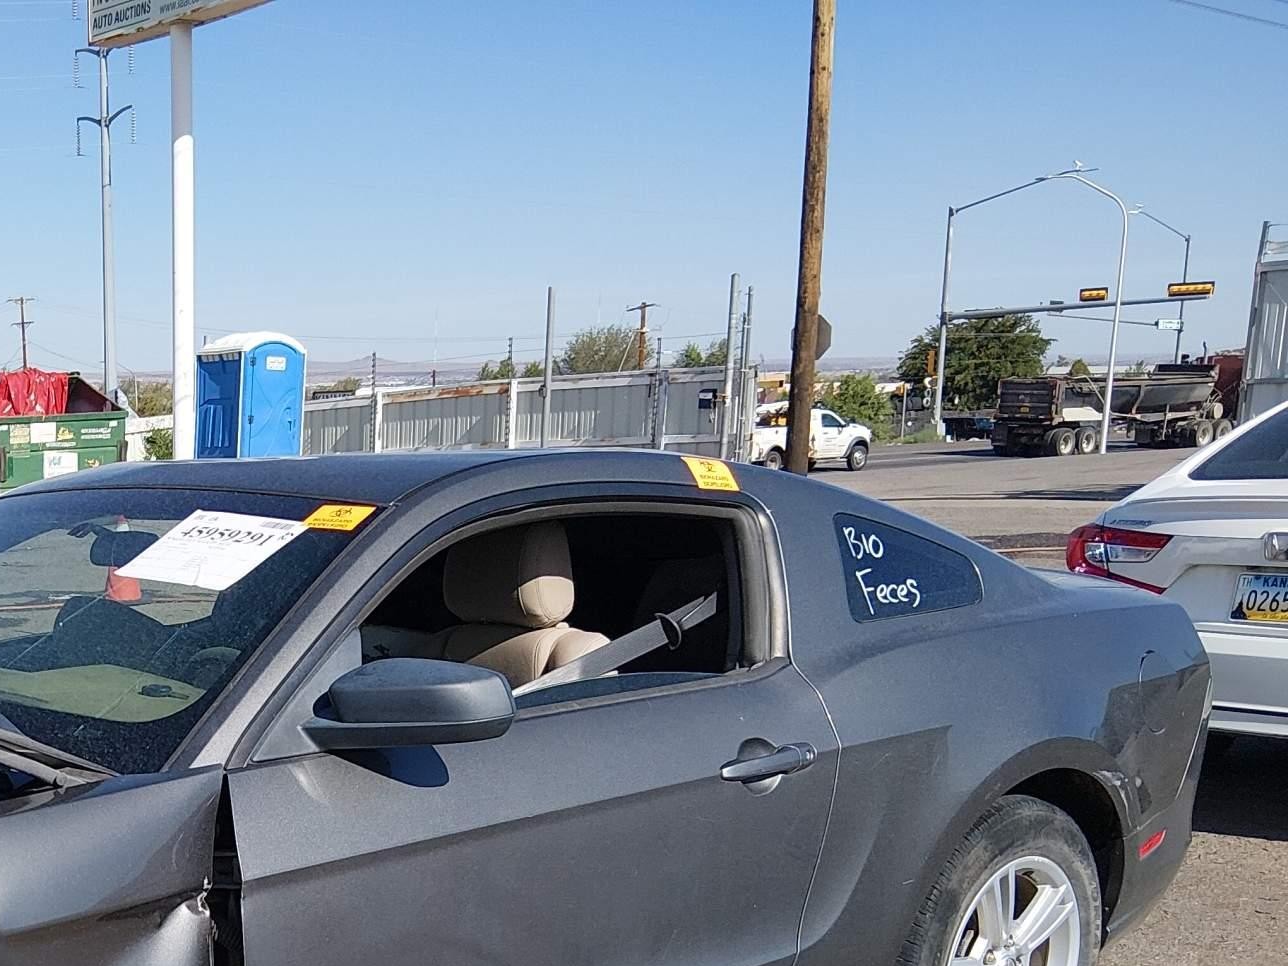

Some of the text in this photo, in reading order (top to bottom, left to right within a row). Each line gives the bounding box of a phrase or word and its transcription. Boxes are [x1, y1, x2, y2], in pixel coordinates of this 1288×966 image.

[92, 1, 151, 31] AUTO AUCTIONS
[180, 525, 275, 546] 45959291
[842, 526, 884, 560] BIO
[855, 568, 921, 616] Feces
[1262, 576, 1288, 588] KAN
